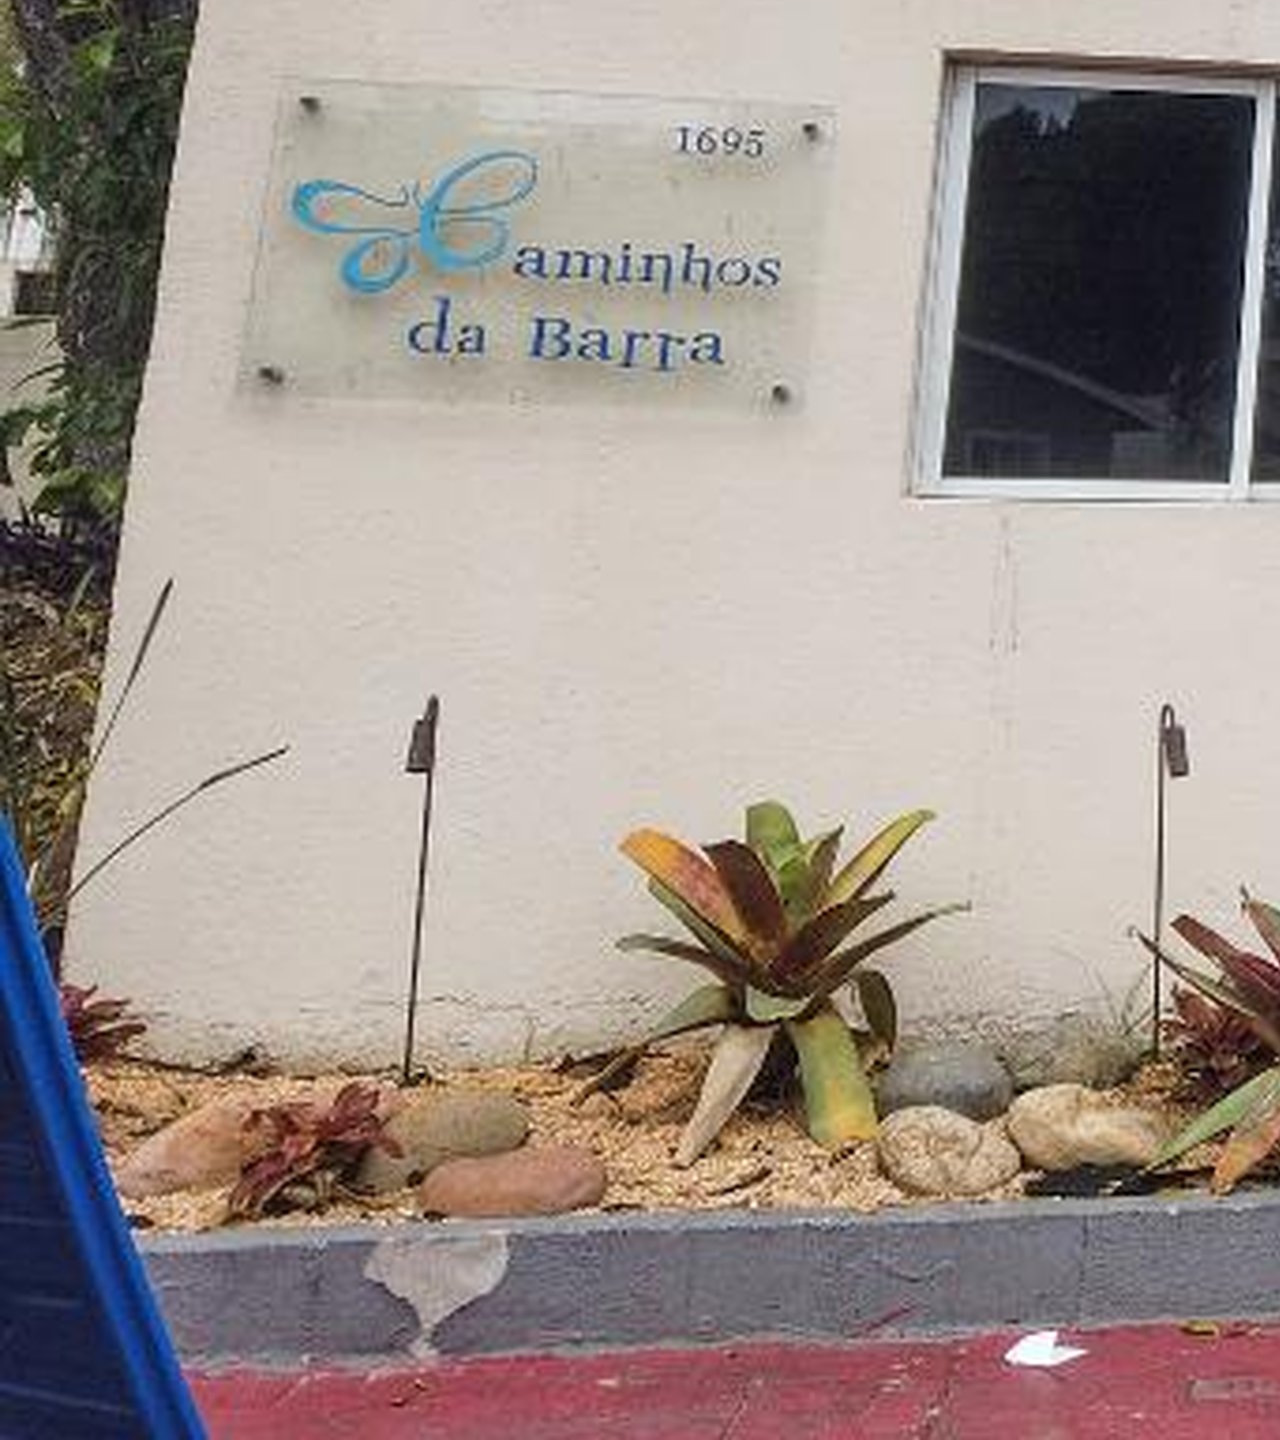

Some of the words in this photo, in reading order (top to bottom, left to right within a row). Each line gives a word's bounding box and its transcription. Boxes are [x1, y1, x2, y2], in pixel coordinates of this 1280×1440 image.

[677, 125, 765, 158] 1695
[418, 150, 783, 294] Caminhos
[408, 298, 486, 358] da
[528, 317, 727, 372] Barra
